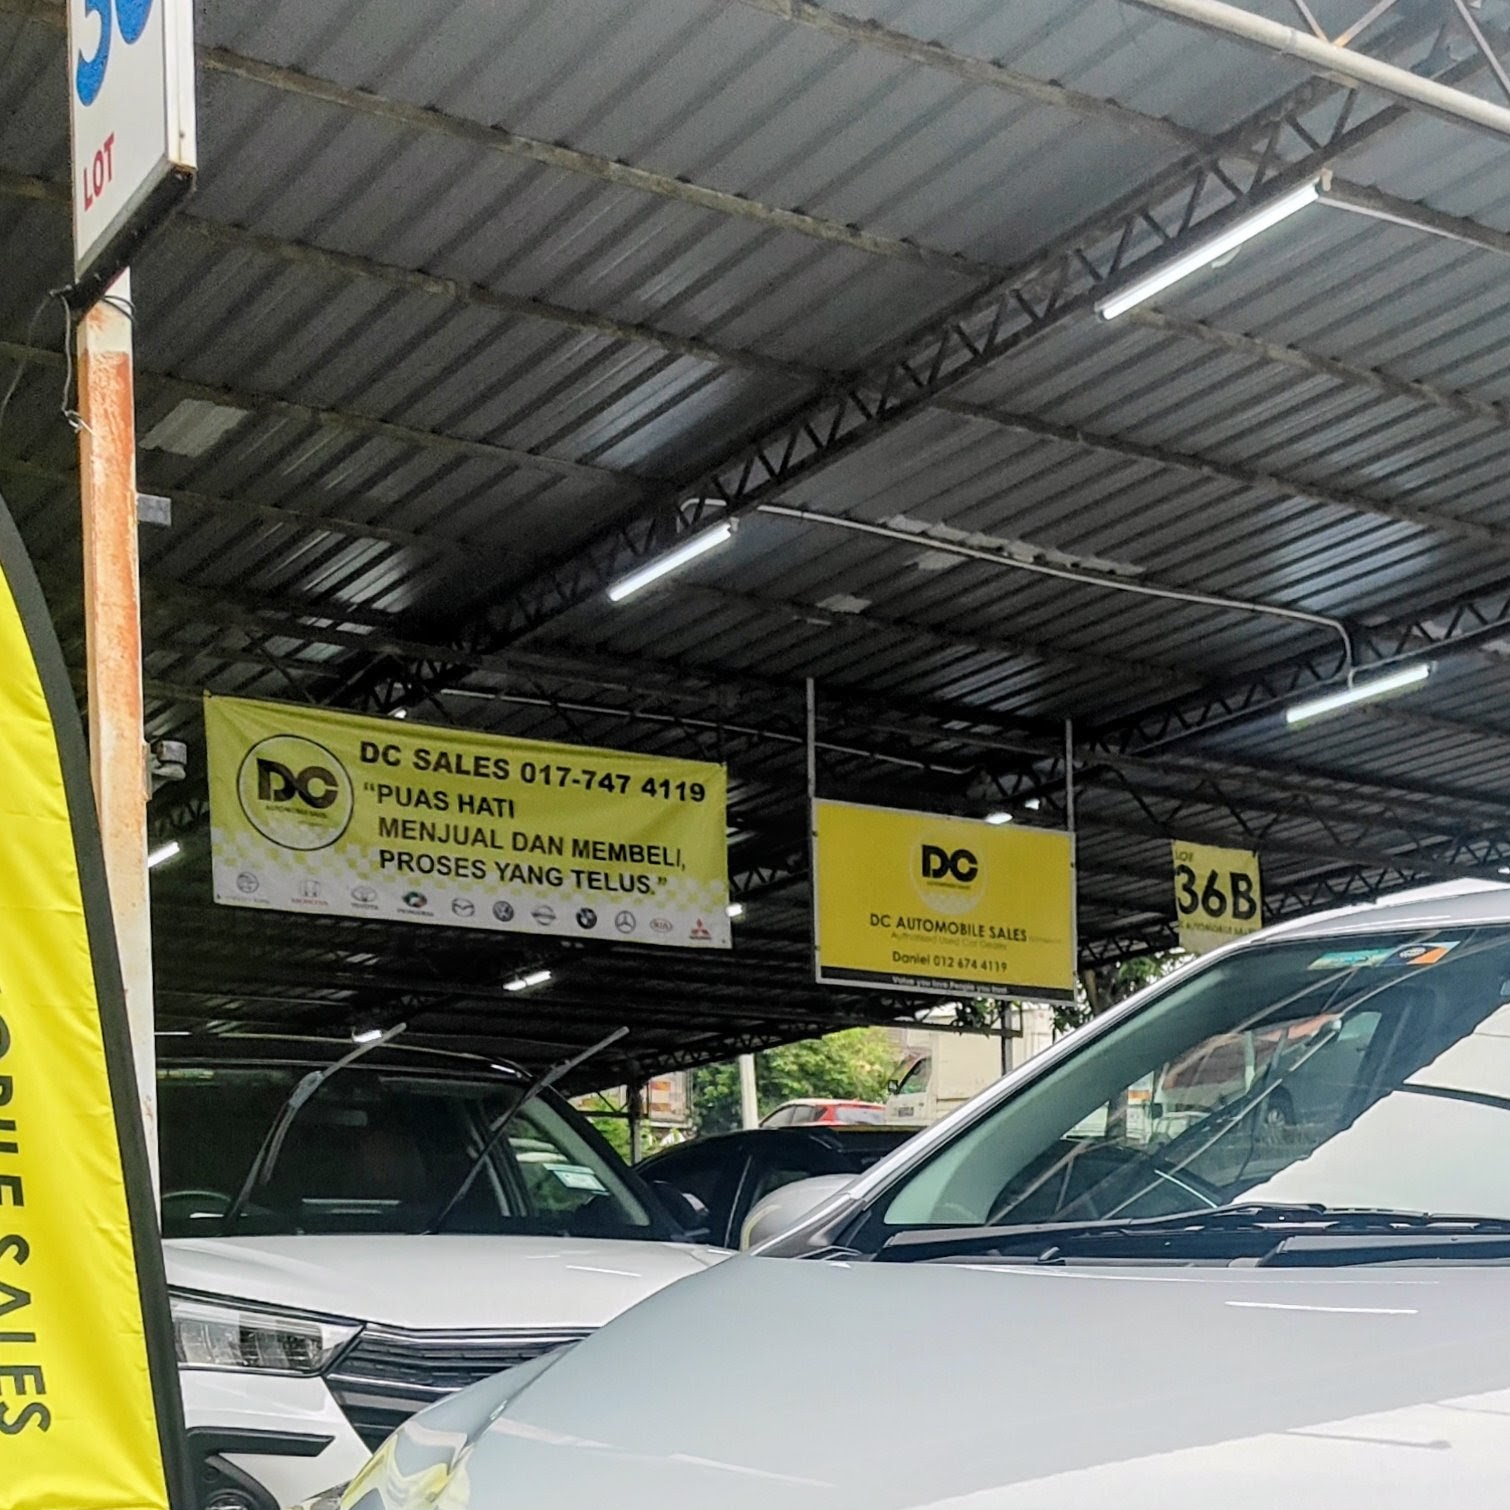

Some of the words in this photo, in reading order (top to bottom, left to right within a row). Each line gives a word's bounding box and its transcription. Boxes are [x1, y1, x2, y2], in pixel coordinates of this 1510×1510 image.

[83, 132, 115, 212] LOT
[256, 757, 339, 809] DC
[360, 741, 402, 767] DC
[412, 748, 510, 780] SALES
[520, 762, 631, 794] 017-747
[641, 777, 706, 803] 4119
[458, 793, 515, 819] HATI
[379, 817, 503, 850] MENJUAL
[512, 832, 564, 856] DAN
[572, 839, 686, 871] MEMBELI,
[921, 844, 979, 882] DC
[380, 850, 486, 880] PROSES
[494, 860, 563, 887] YANG
[1176, 864, 1257, 920] 36B
[870, 912, 891, 927] DC
[896, 916, 985, 938] AUTOMOBILE
[989, 926, 1027, 942] SALES
[892, 951, 931, 965] Daniel
[933, 955, 954, 967] 012
[958, 957, 977, 969] 674
[981, 960, 1007, 972] 4119
